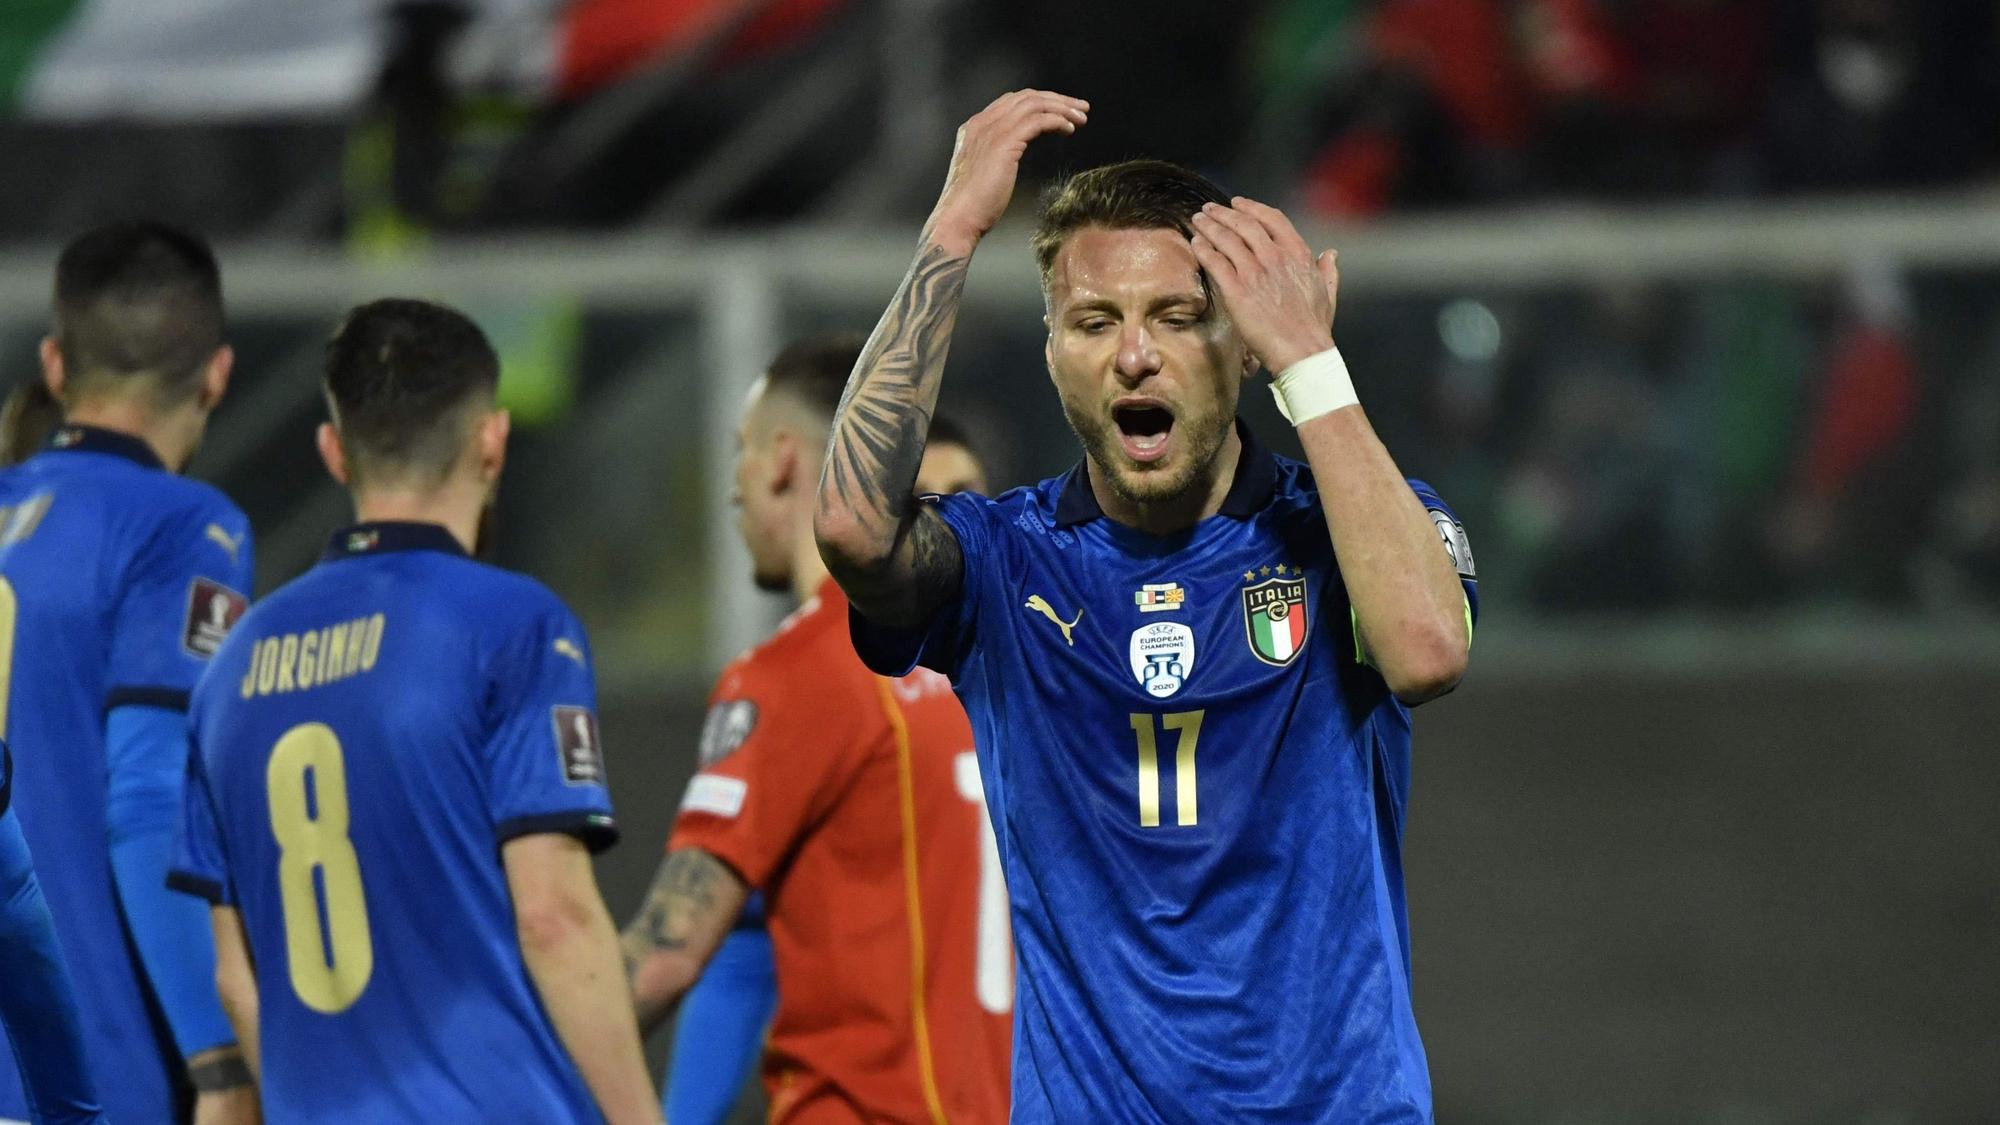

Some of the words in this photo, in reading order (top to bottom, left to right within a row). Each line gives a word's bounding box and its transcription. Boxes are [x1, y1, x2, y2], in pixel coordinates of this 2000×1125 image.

[1249, 585, 1302, 606] ITALIA
[1140, 635, 1184, 645] EUROPEAN
[1140, 641, 1184, 651] CHAMPIONS
[240, 612, 386, 699] JORGINHO
[1152, 683, 1175, 691] 2020
[1129, 709, 1205, 827] 17
[267, 722, 374, 1014] 8
